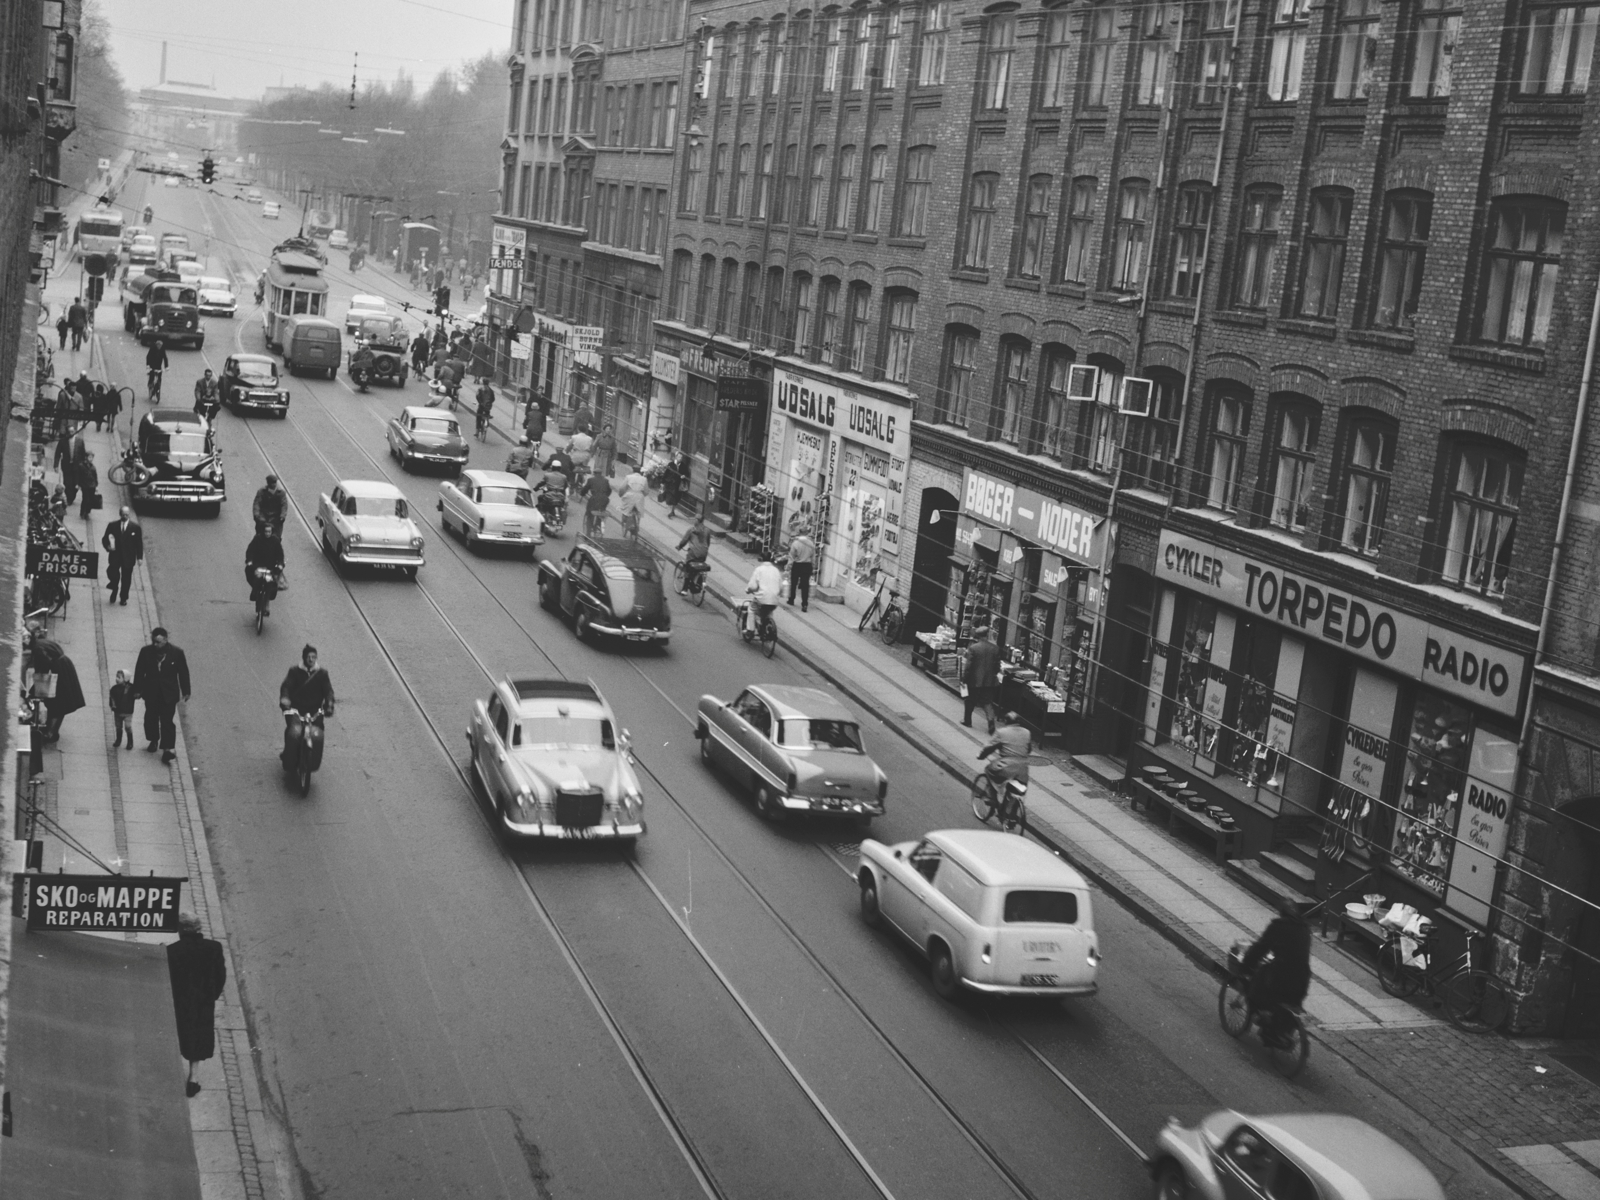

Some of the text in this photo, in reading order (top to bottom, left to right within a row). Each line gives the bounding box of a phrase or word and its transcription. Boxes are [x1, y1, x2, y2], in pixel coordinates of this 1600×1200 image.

[491, 259, 524, 269] TÆNDER
[575, 328, 600, 336] SKJOLD
[719, 398, 741, 409] STAR
[778, 380, 836, 428] UDSALG
[850, 403, 896, 444] UDSALG
[965, 472, 1015, 526] BØGER
[1037, 500, 1094, 559] NODER
[41, 552, 88, 565] DAME-
[37, 562, 88, 576] FRISØR
[1043, 568, 1058, 588] SALG
[1164, 542, 1509, 698] CYKLER TORPEDO RADIO
[1271, 707, 1294, 724] ARTIKLER
[1345, 726, 1389, 763] CYKLEDELE
[1467, 784, 1507, 820] RADIO
[36, 885, 174, 909] SKO OG MAPPE
[46, 910, 164, 927] REPARATION
